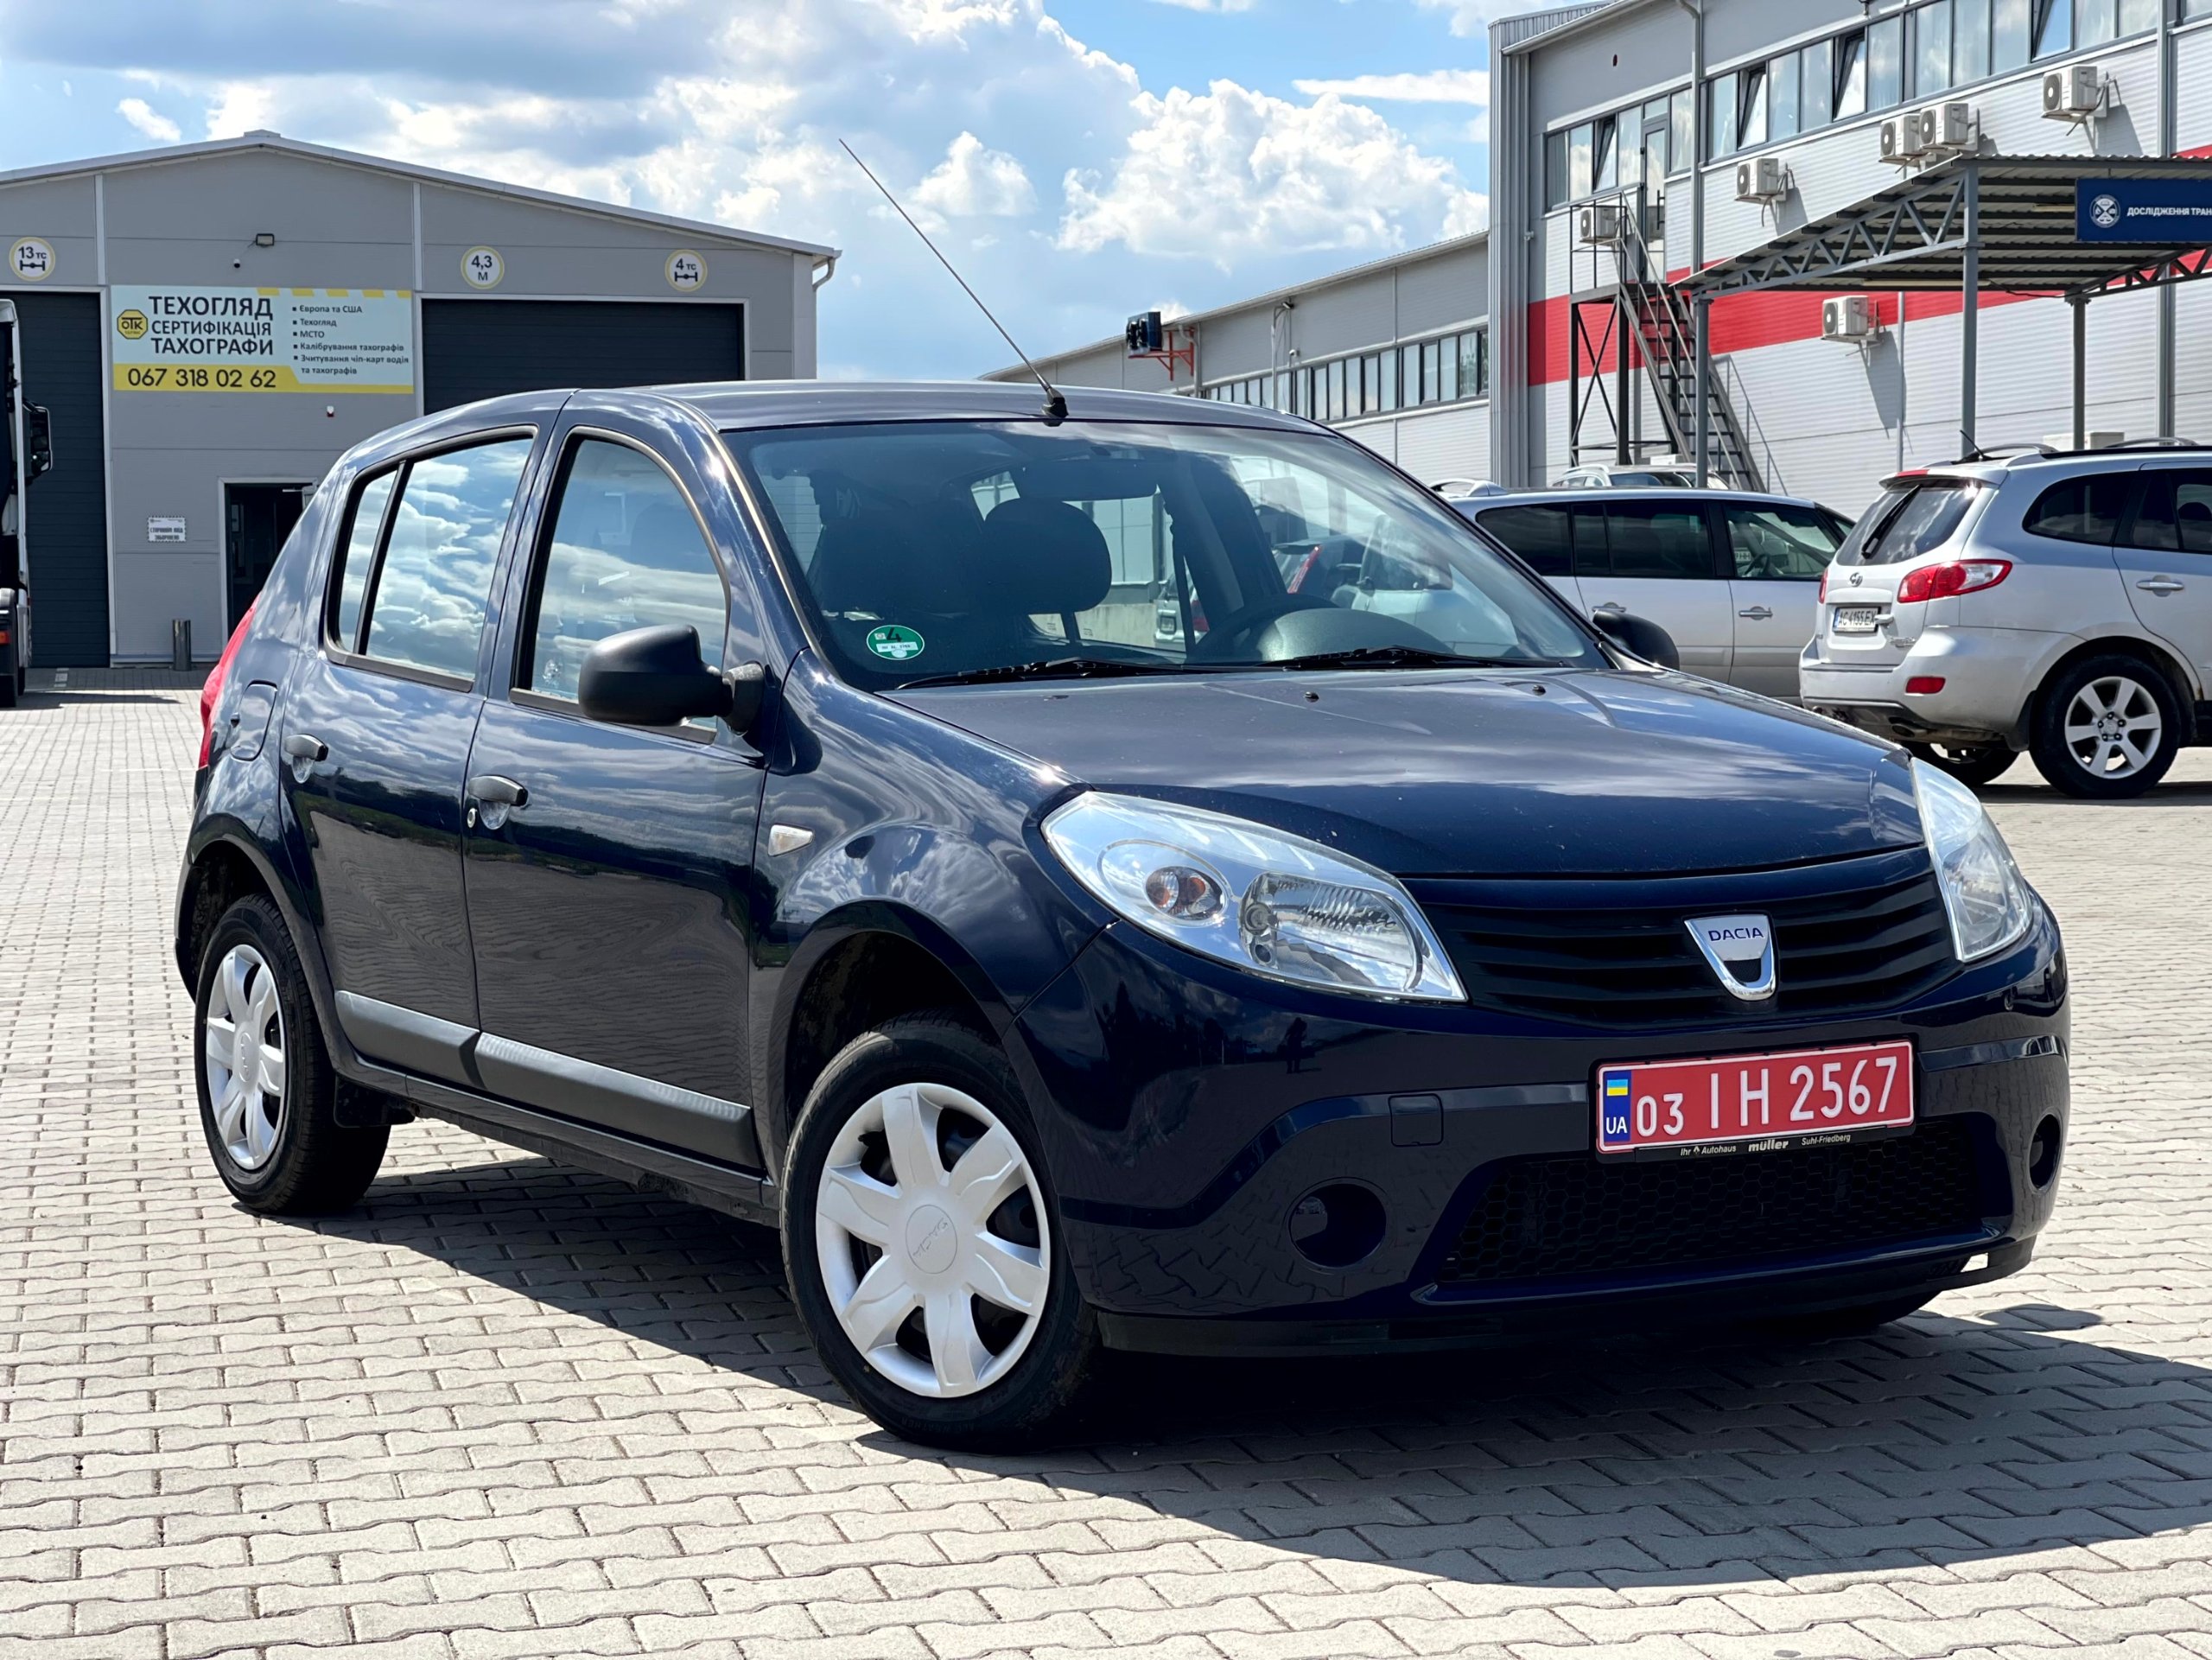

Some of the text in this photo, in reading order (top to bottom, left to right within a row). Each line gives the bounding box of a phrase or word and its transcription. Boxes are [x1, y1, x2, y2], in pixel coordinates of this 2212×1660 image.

[2126, 207, 2190, 217] ДОСЛІДЖЕННЯ
[18, 246, 35, 259] 13
[471, 255, 493, 270] 4,3
[676, 258, 684, 270] 4
[149, 296, 273, 321] ТЕХОГЛЯД
[299, 305, 330, 314] Європа
[151, 321, 271, 339] СЕРТИФІКАЦІЯ
[300, 318, 337, 328] Техогляд
[150, 338, 274, 355] ТАХОГРАФИ
[300, 342, 404, 353] Калібрування тахографів
[301, 354, 349, 363] Зчитування
[128, 368, 276, 388] 067 318 02 62
[312, 366, 358, 375] тахографів
[887, 627, 902, 642] 4
[1707, 927, 1764, 942] DACIA
[1637, 1093, 1684, 1137] 03
[1789, 1055, 1897, 1122] 2567
[1605, 1116, 1628, 1135] UA
[1681, 1134, 1851, 1156] Ihr Autohaus müller Suhl-Friedberg
